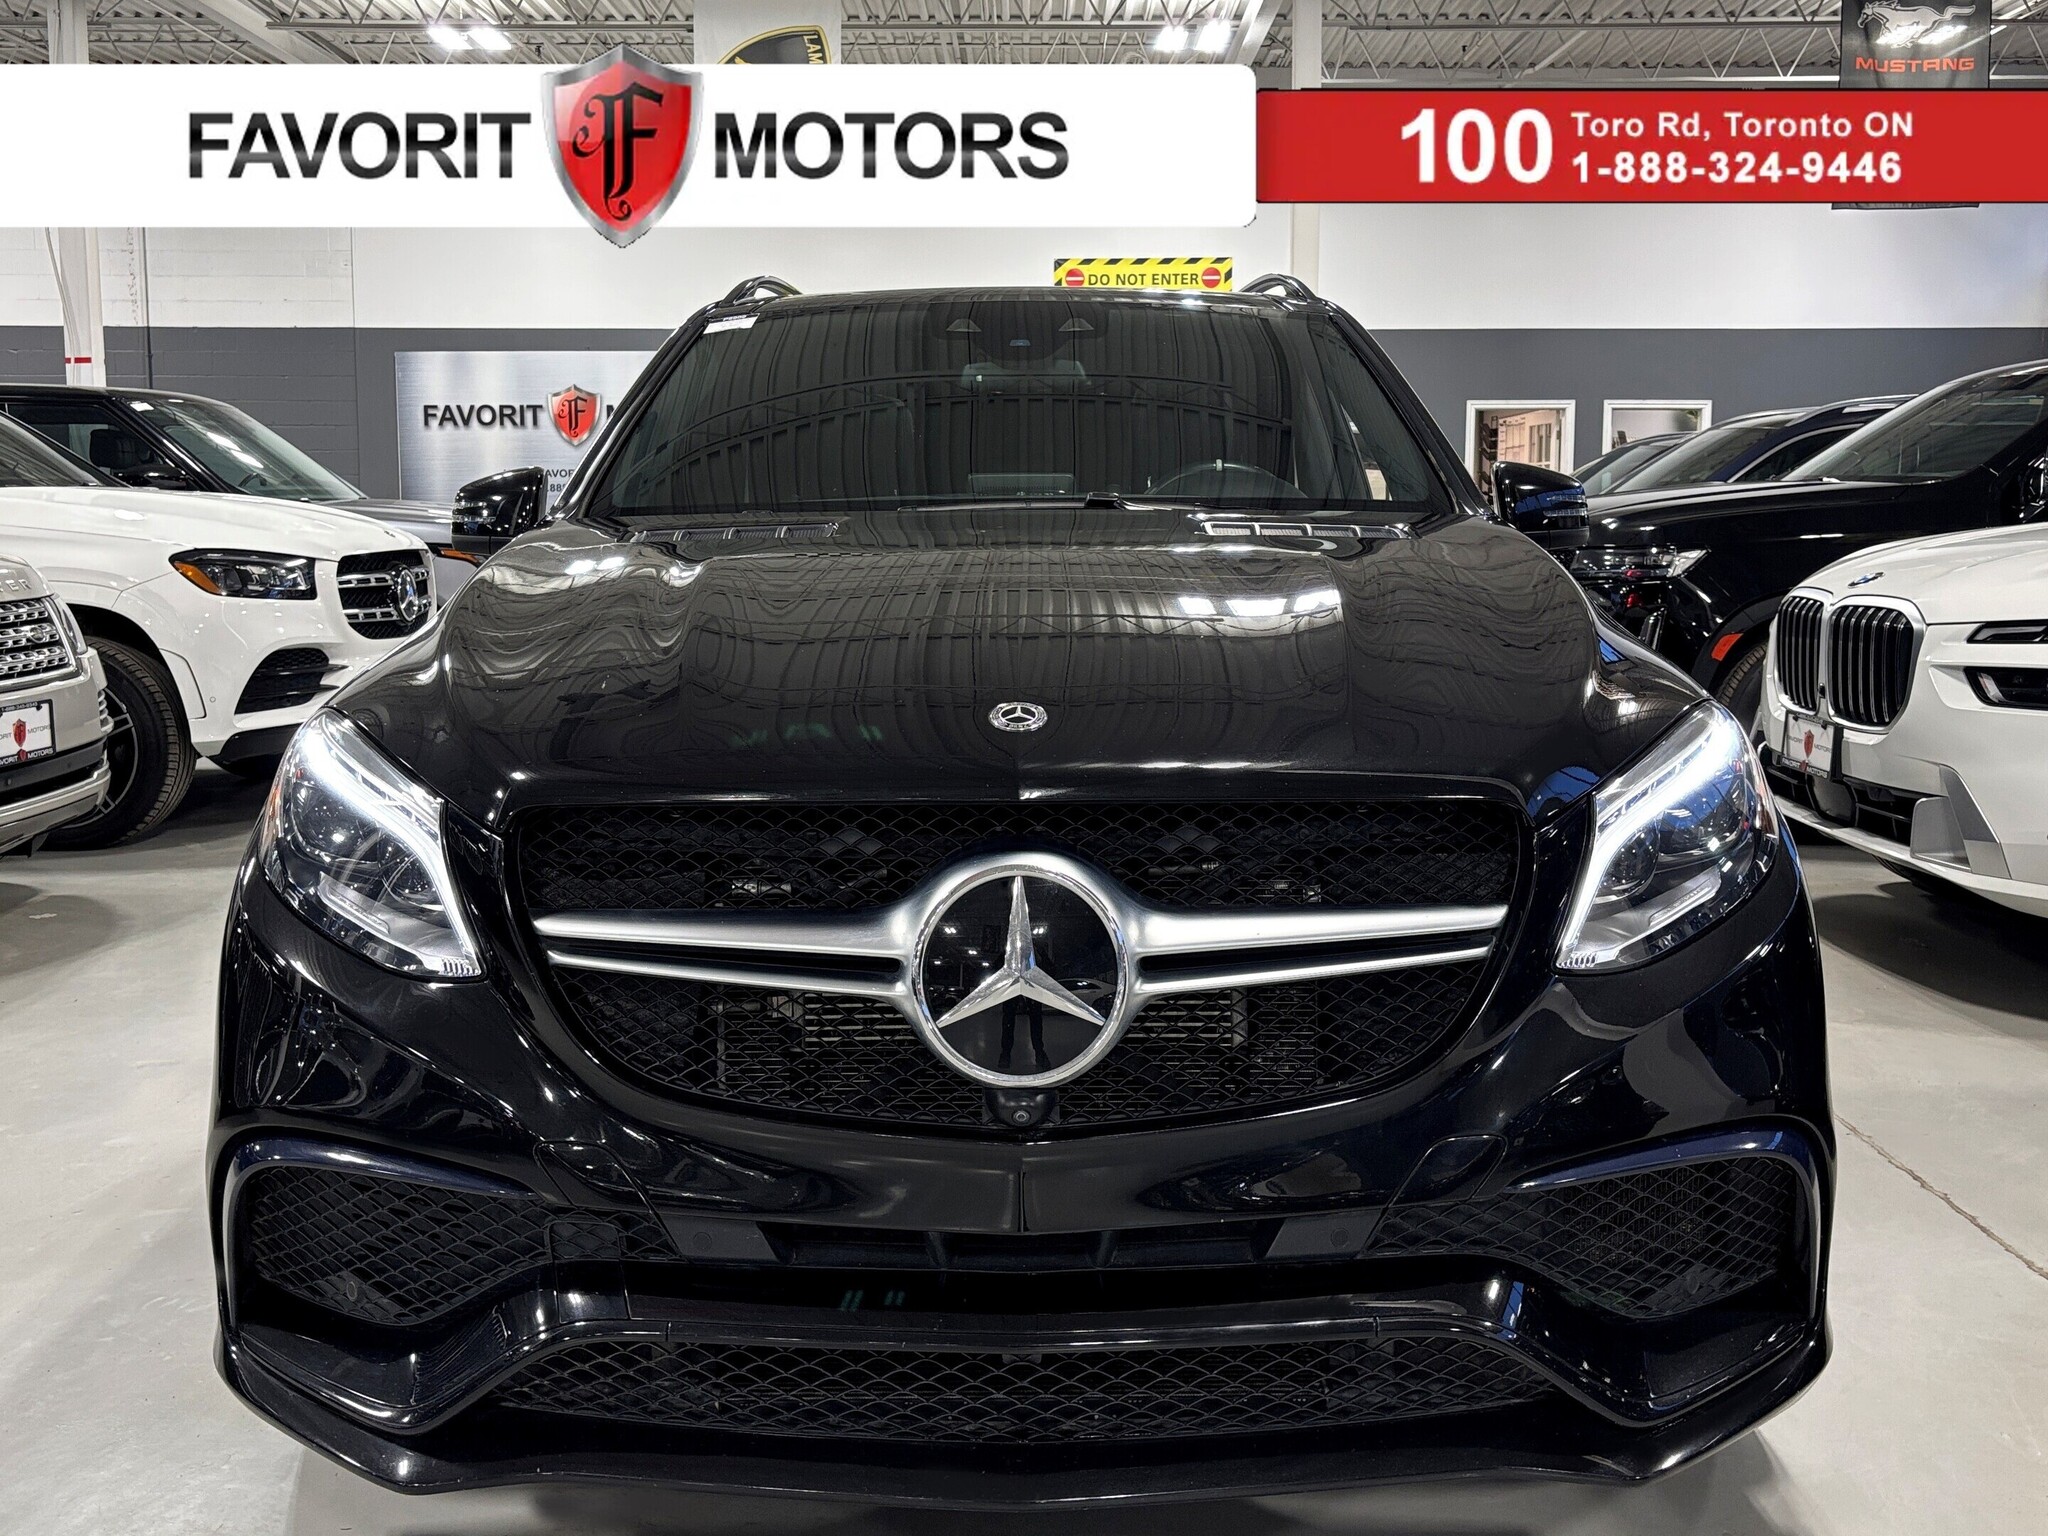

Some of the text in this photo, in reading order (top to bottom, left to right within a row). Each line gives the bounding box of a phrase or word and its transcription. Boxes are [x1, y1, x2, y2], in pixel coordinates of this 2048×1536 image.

[1855, 56, 1976, 73] MUSTANG
[1088, 273, 1199, 286] DO NOT ENTER
[423, 404, 543, 427] FAVORIT
